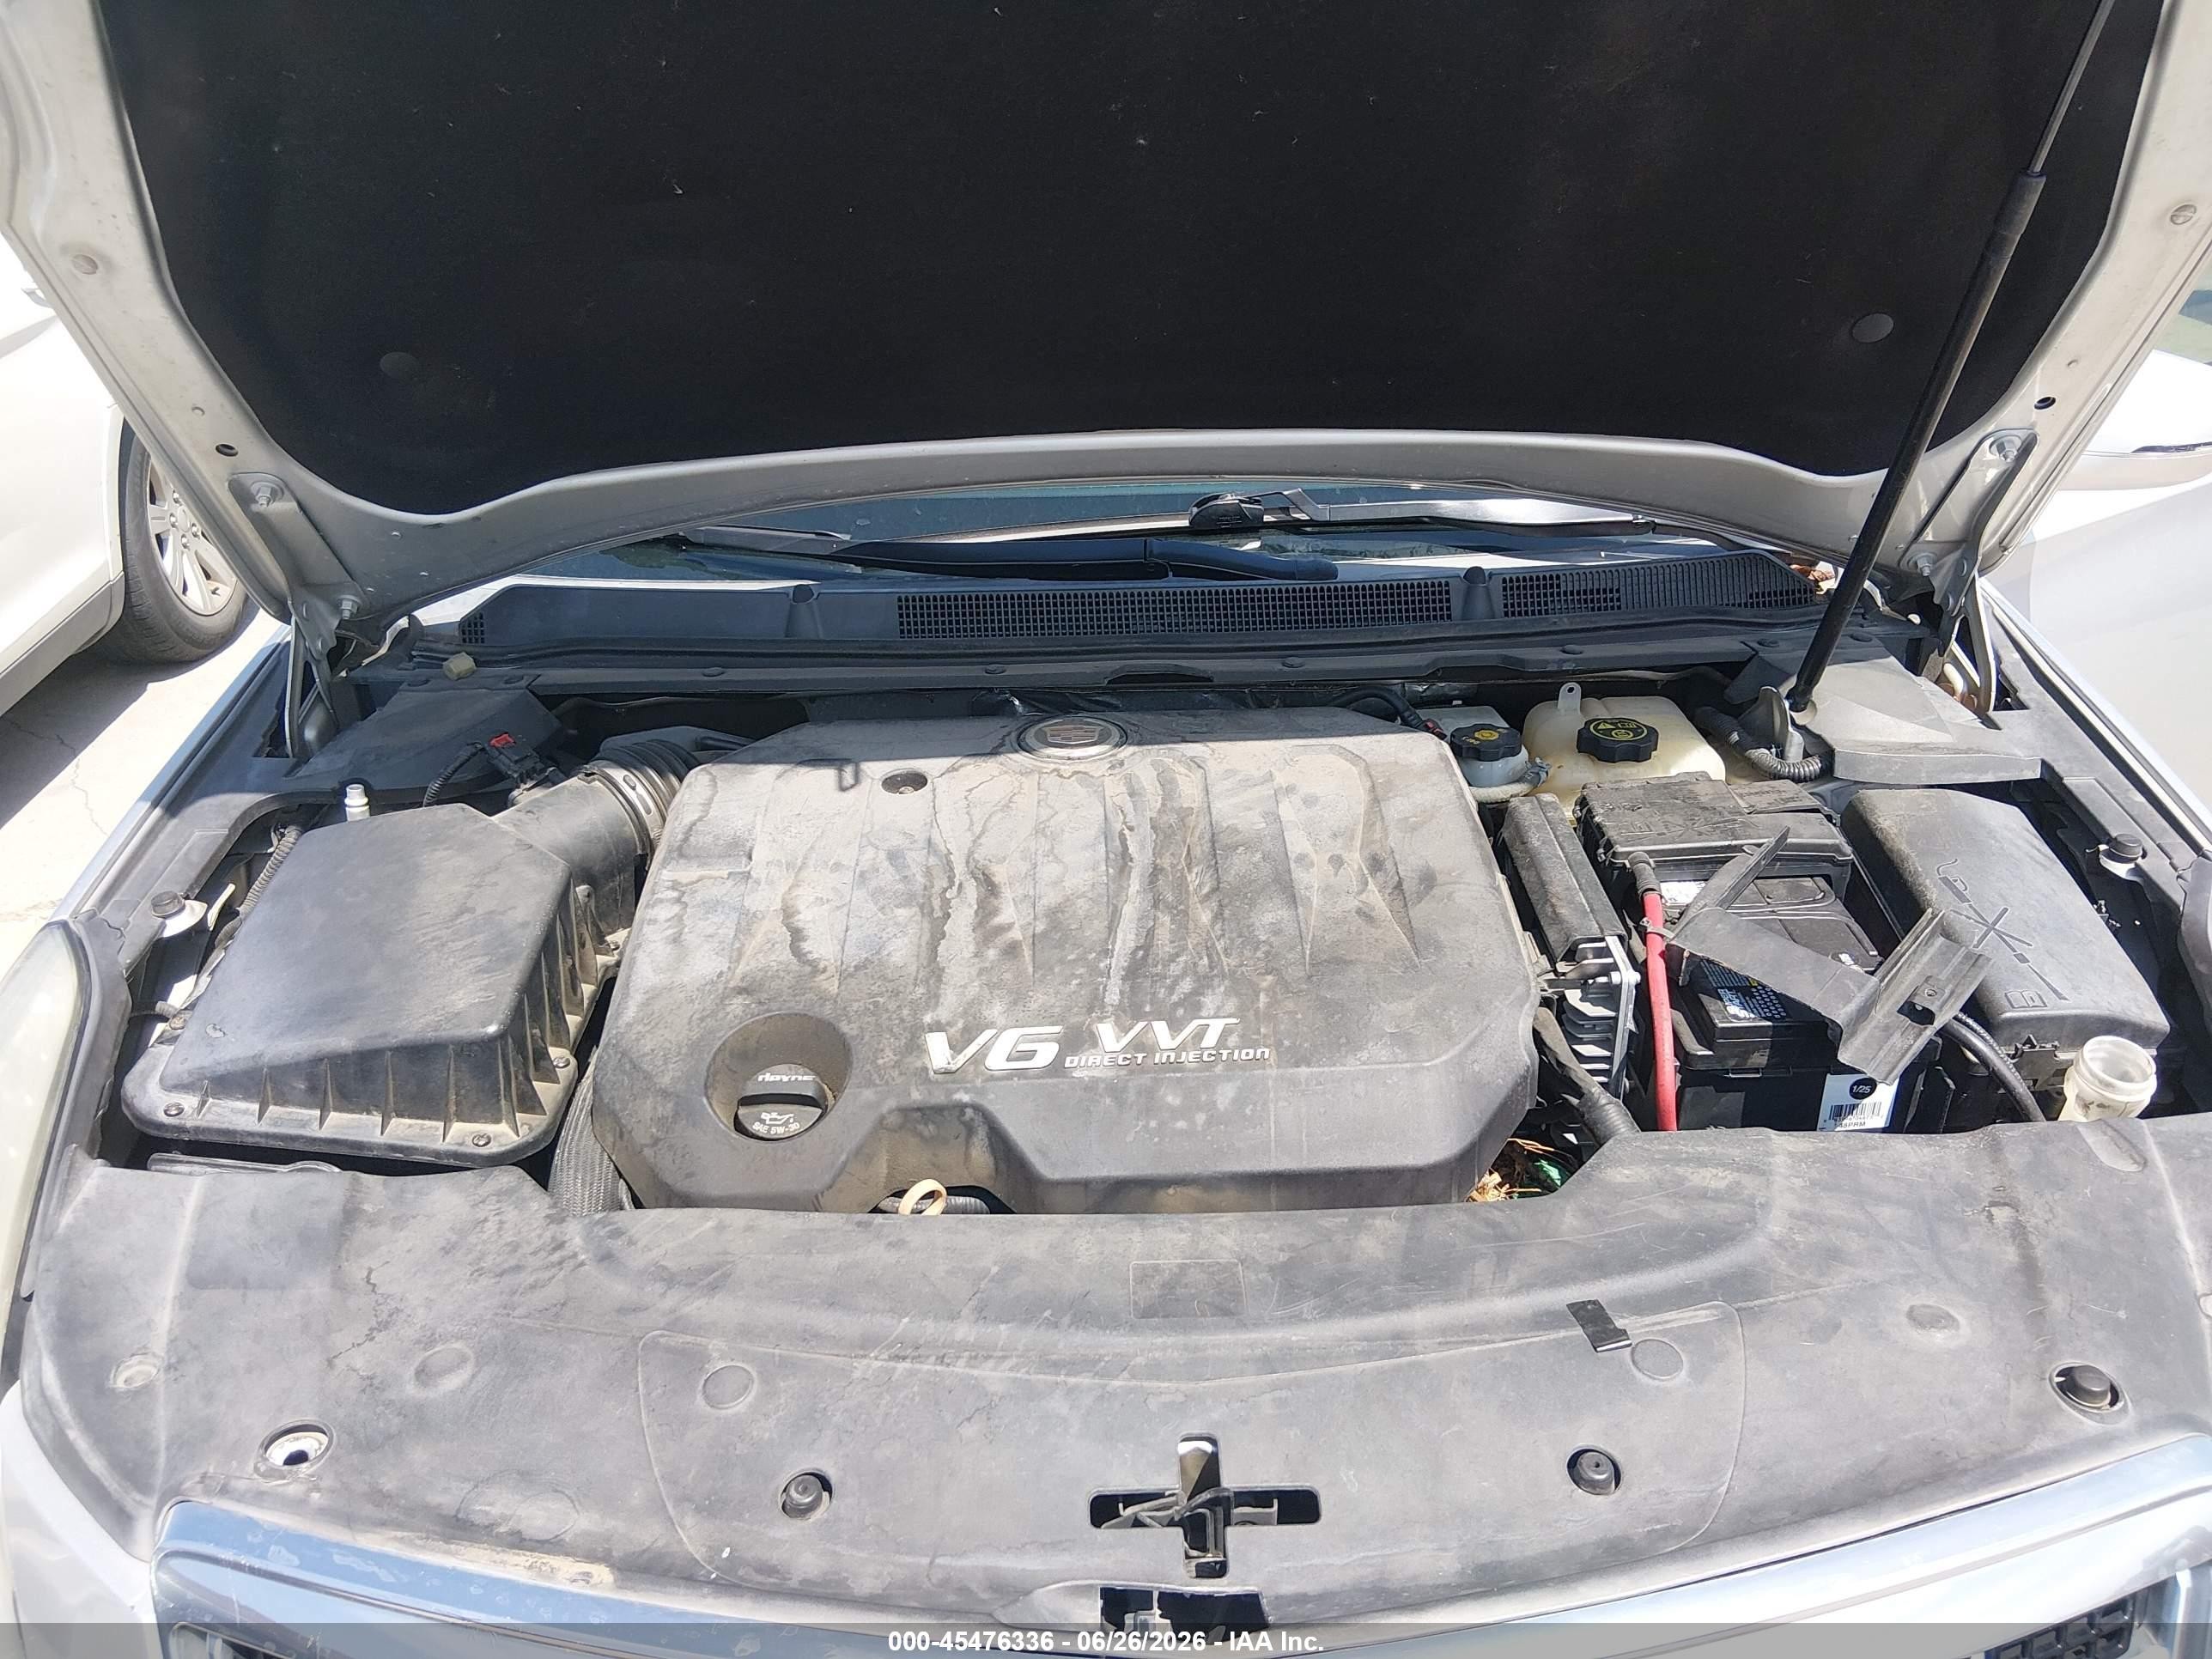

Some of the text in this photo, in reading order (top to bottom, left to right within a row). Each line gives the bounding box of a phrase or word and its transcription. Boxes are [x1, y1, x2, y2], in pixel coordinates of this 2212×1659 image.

[925, 1017, 1241, 1074] V6 VVT
[1064, 1047, 1271, 1069] DIRECT INJECTION
[1851, 1085, 1872, 1094] 1/25
[752, 1121, 800, 1134] SAE 5W-30
